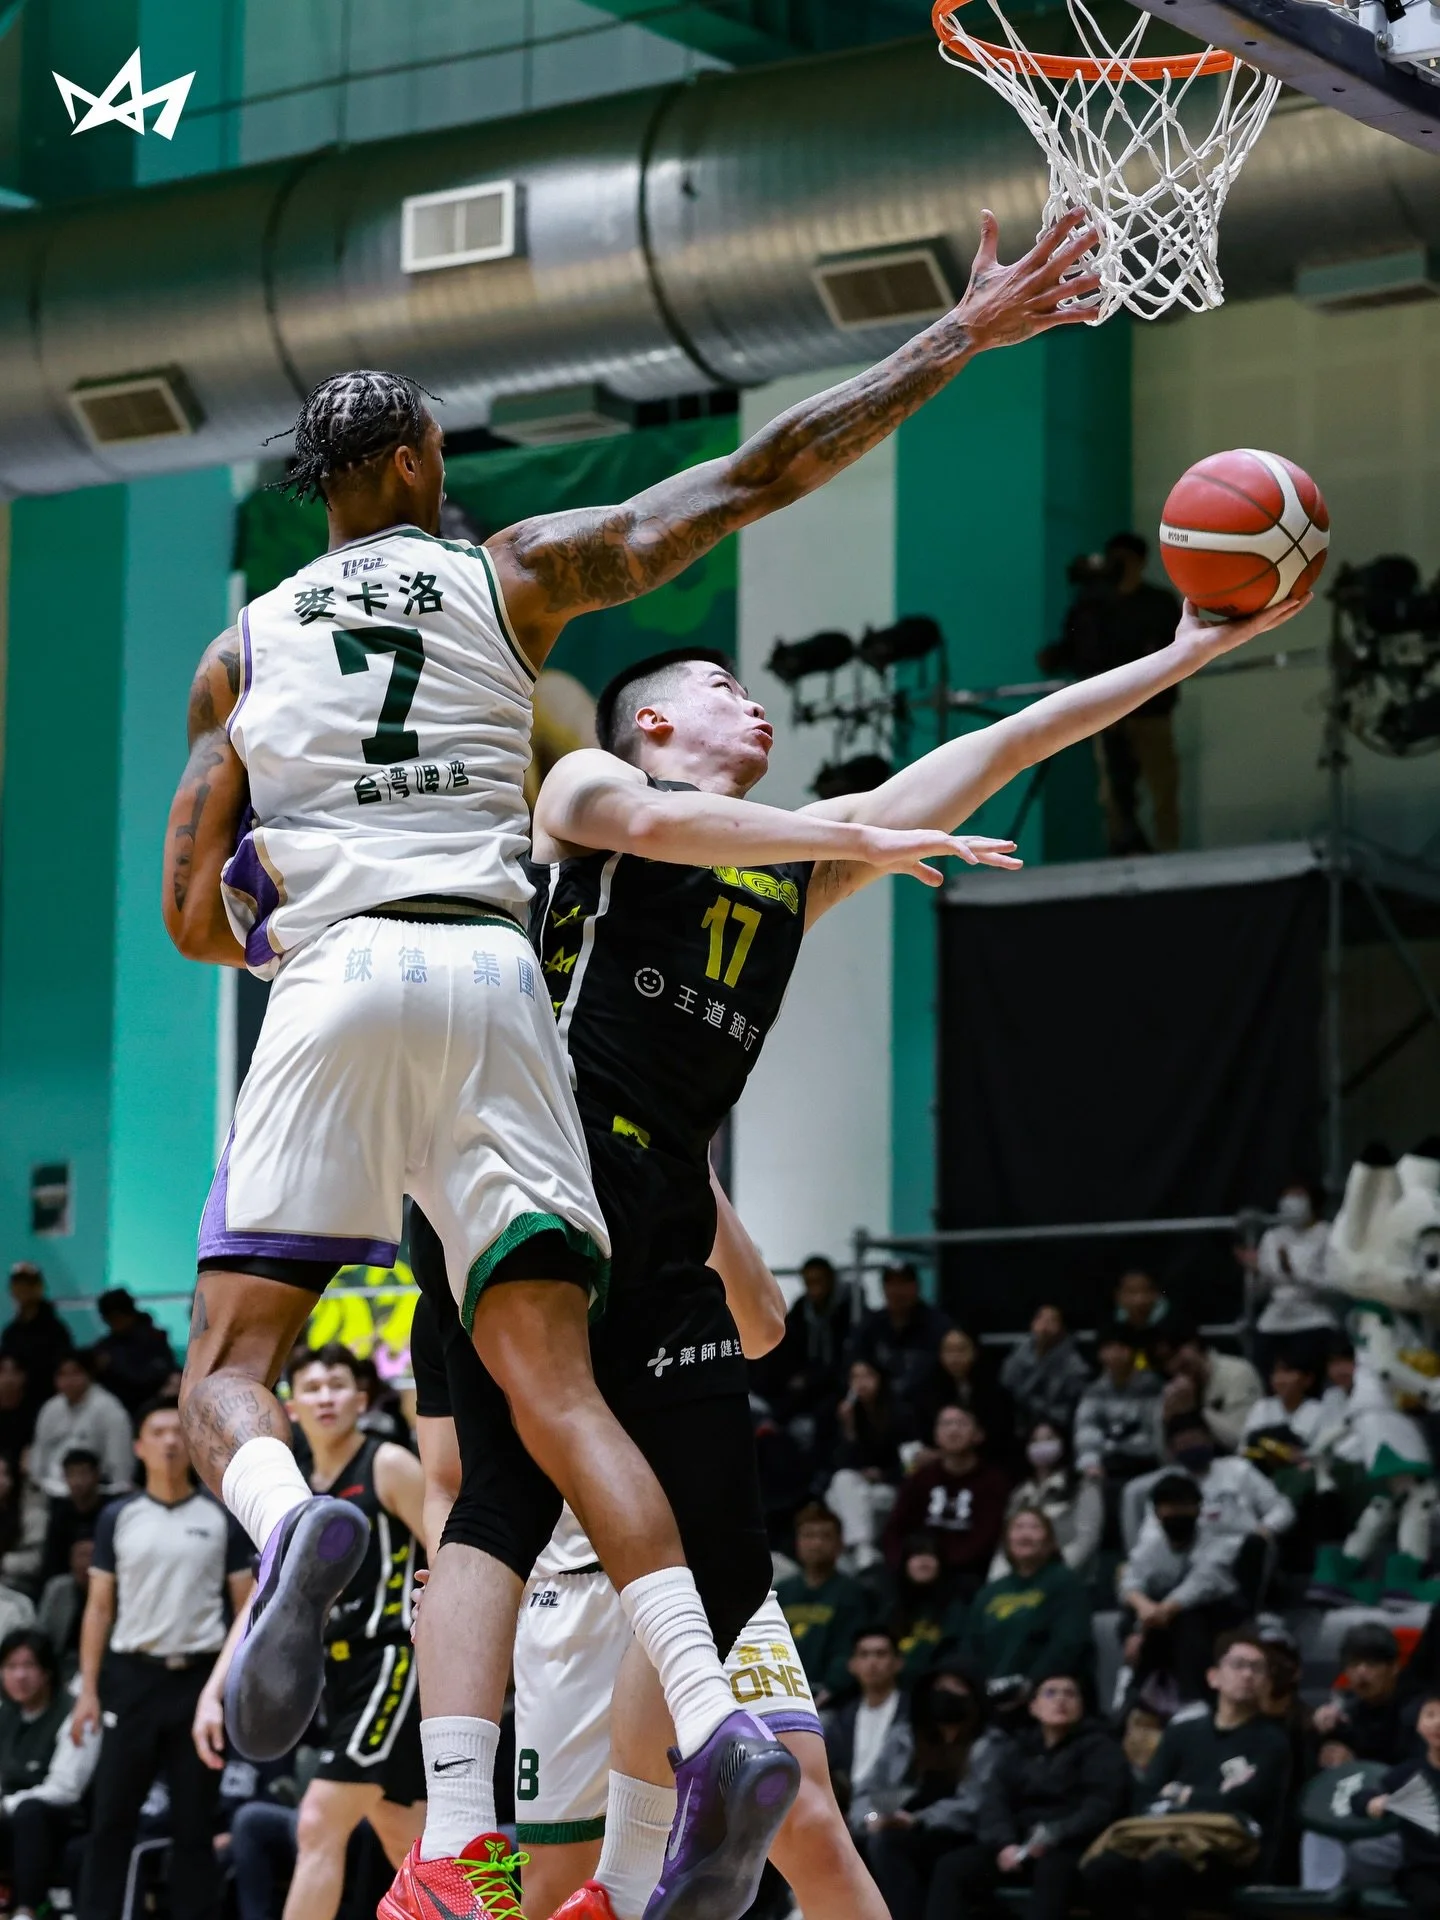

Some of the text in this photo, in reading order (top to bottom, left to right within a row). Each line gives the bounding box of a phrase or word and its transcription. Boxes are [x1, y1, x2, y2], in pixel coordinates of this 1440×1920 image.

[294, 571, 444, 627] 麥卡洛
[332, 626, 425, 765] 7
[699, 865, 799, 915] NGS
[701, 895, 762, 988] 17
[344, 946, 536, 1001] 錸德集團
[674, 985, 760, 1051] 王道銀行
[530, 1590, 560, 1608] TBL
[729, 1664, 811, 1704] ONE
[517, 1748, 539, 1801] 8
